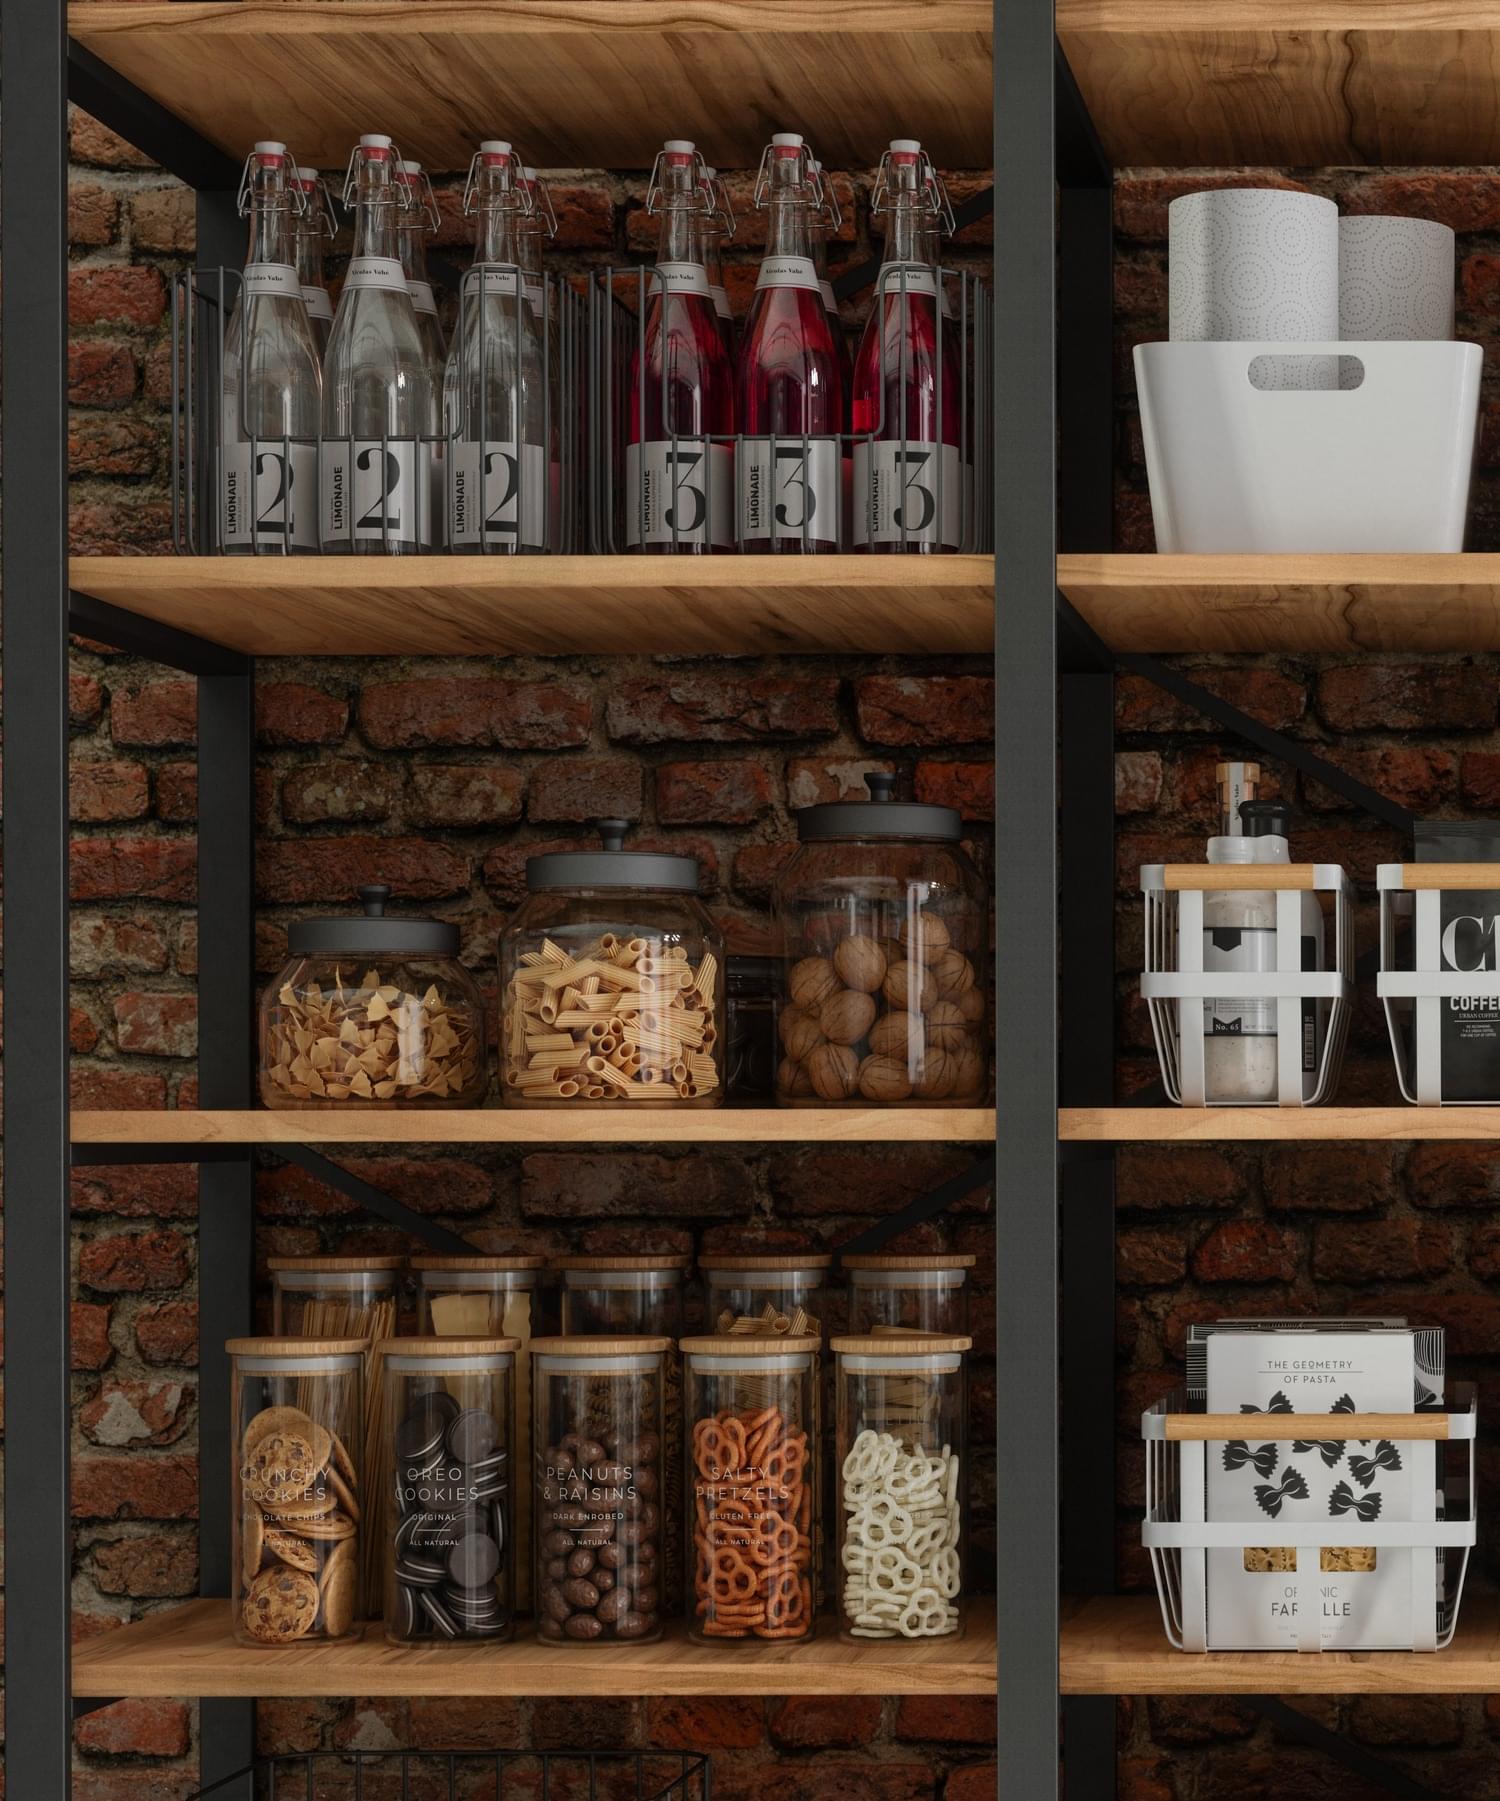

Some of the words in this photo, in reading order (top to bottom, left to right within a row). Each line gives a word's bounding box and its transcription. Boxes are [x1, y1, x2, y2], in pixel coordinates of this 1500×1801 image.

[250, 453, 295, 534] 2
[356, 448, 401, 530] 2
[479, 452, 520, 533] 2
[664, 452, 706, 531] 3
[774, 447, 817, 527] 3
[893, 451, 935, 531] 3
[228, 471, 237, 534] LIMONADE
[334, 465, 343, 530] LIMONADE
[456, 470, 465, 534] LIMONADE
[750, 464, 760, 529] LIMONADE
[1267, 1360, 1288, 1369] THE
[1292, 1360, 1353, 1370] GEOMETRY
[1283, 1375, 1299, 1384] OF
[1303, 1375, 1336, 1384] PASTA
[240, 1467, 330, 1481] CRUNCHY
[407, 1467, 462, 1481] OREO
[546, 1466, 632, 1481] PEANUTS
[712, 1466, 769, 1481] SALTY
[243, 1487, 326, 1502] COOKIES
[395, 1487, 479, 1502] COOKIES
[543, 1486, 551, 1500] &
[559, 1486, 637, 1501] RAISINS
[696, 1485, 790, 1501] PRETZELS
[411, 1513, 457, 1521] ORIGINAL
[552, 1512, 575, 1521] DARK
[578, 1511, 624, 1521] ENROBED
[710, 1511, 744, 1520] GLUTEN
[577, 1538, 612, 1546] NATURAL
[730, 1538, 765, 1546] NATURAL
